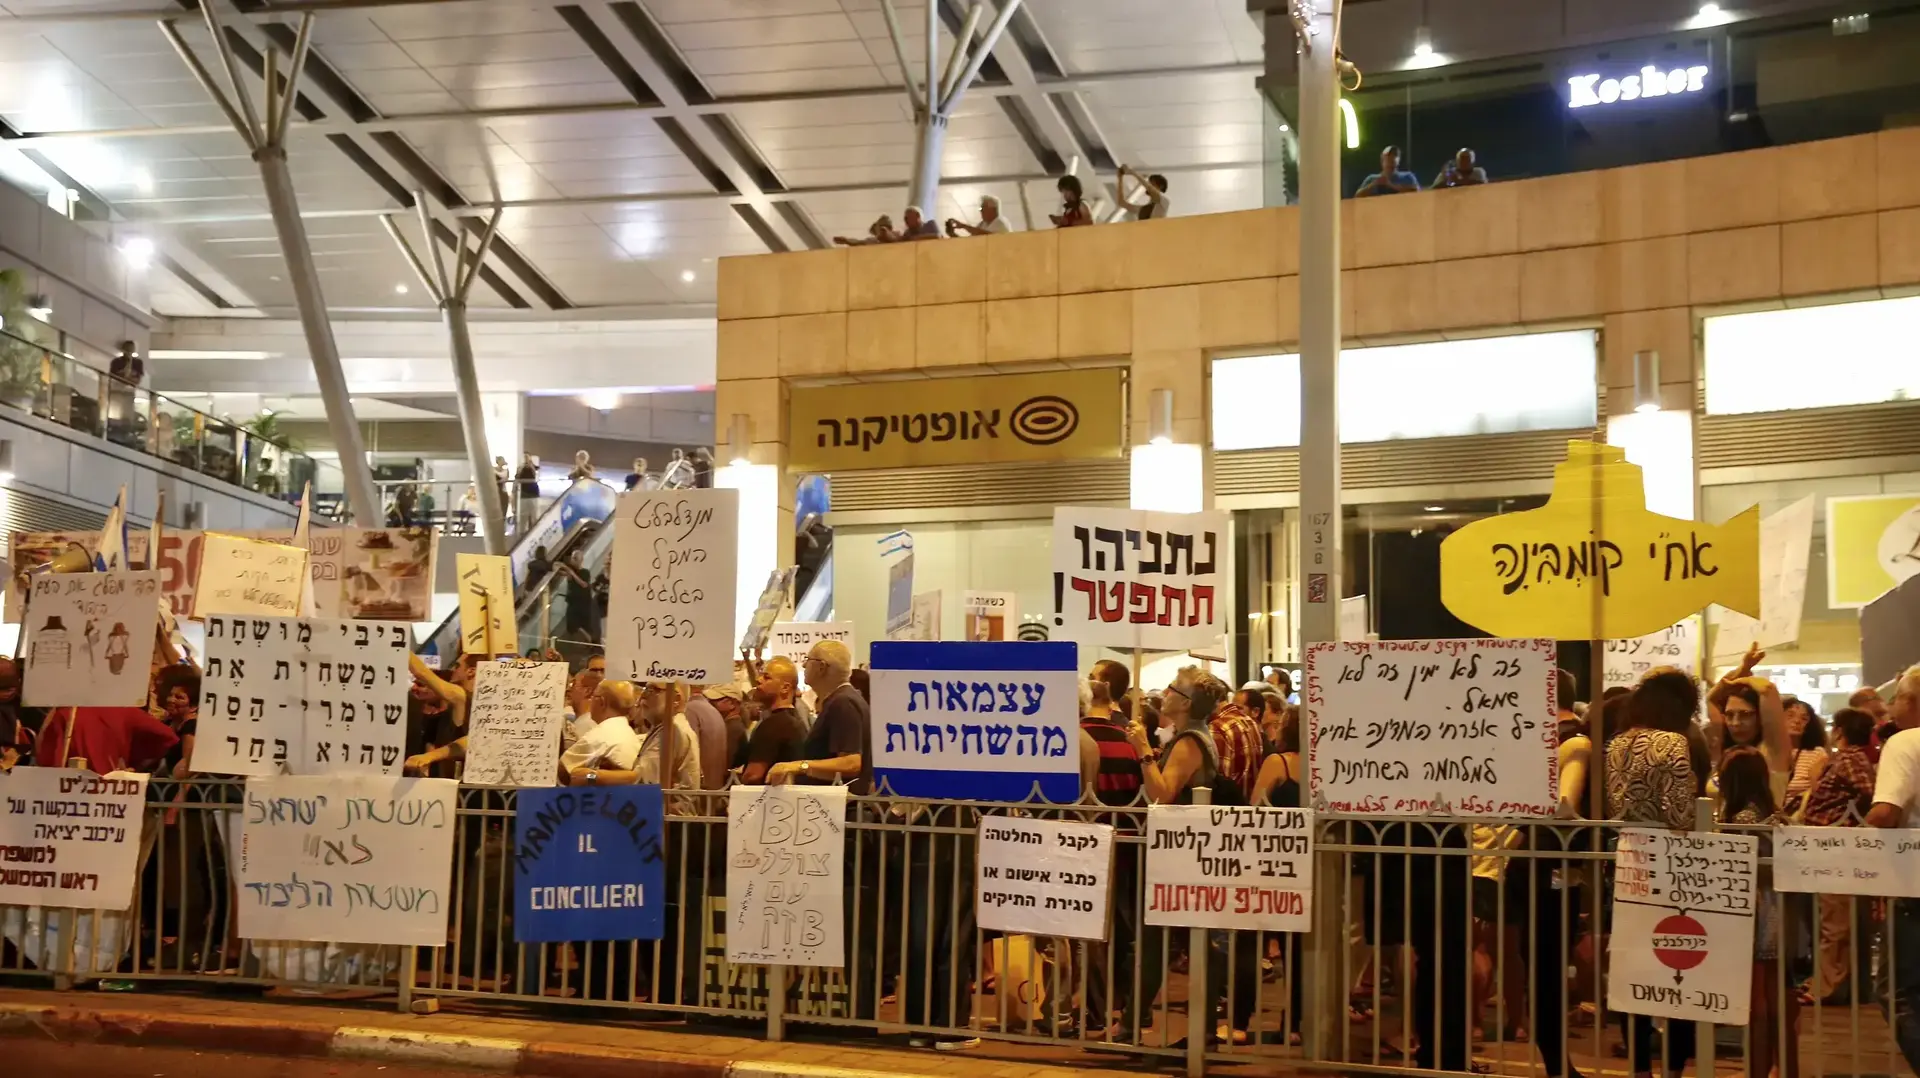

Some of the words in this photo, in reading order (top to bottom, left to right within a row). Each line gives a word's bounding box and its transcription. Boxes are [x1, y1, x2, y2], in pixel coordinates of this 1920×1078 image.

[1568, 62, 1709, 109] Kosher
[817, 408, 1000, 451] אופטיקנה
[1074, 525, 1216, 576] נתניהו
[777, 631, 810, 645] מפחד
[1337, 654, 1373, 685] לא
[1377, 662, 1400, 682] זה
[1449, 653, 1482, 681] לא
[1492, 658, 1522, 678] זה
[1404, 664, 1441, 701] ימין
[907, 680, 1046, 716] עצמאות
[885, 722, 1067, 757] מהשחיתות
[1315, 717, 1359, 745] אחים
[1438, 717, 1499, 741] אזרחי
[1329, 758, 1409, 785] בשחיתות
[1423, 756, 1498, 785] למלחמה
[8, 796, 26, 814] על
[33, 799, 90, 818] בבקשה
[248, 791, 328, 826] ישראל
[759, 796, 822, 846] BB
[1210, 807, 1305, 829] מנדלבליט
[34, 823, 80, 841] יציאה
[82, 826, 125, 843] עיכוב
[515, 792, 664, 876] MANDELBLIT
[578, 833, 598, 853] IL
[984, 828, 1043, 845] החלטה:
[1057, 832, 1099, 849] לקבל
[1151, 826, 1211, 862] קלטות
[60, 872, 99, 891] ראש
[983, 866, 998, 880] או
[1005, 867, 1051, 883] אישום
[1059, 869, 1097, 887] כתבי
[245, 871, 333, 909] הליכוד
[530, 883, 645, 911] CONCILIERI
[765, 880, 810, 905] עם
[982, 891, 1036, 908] התיקים
[1149, 883, 1227, 913] שחיתות
[1045, 896, 1093, 913] סגירת
